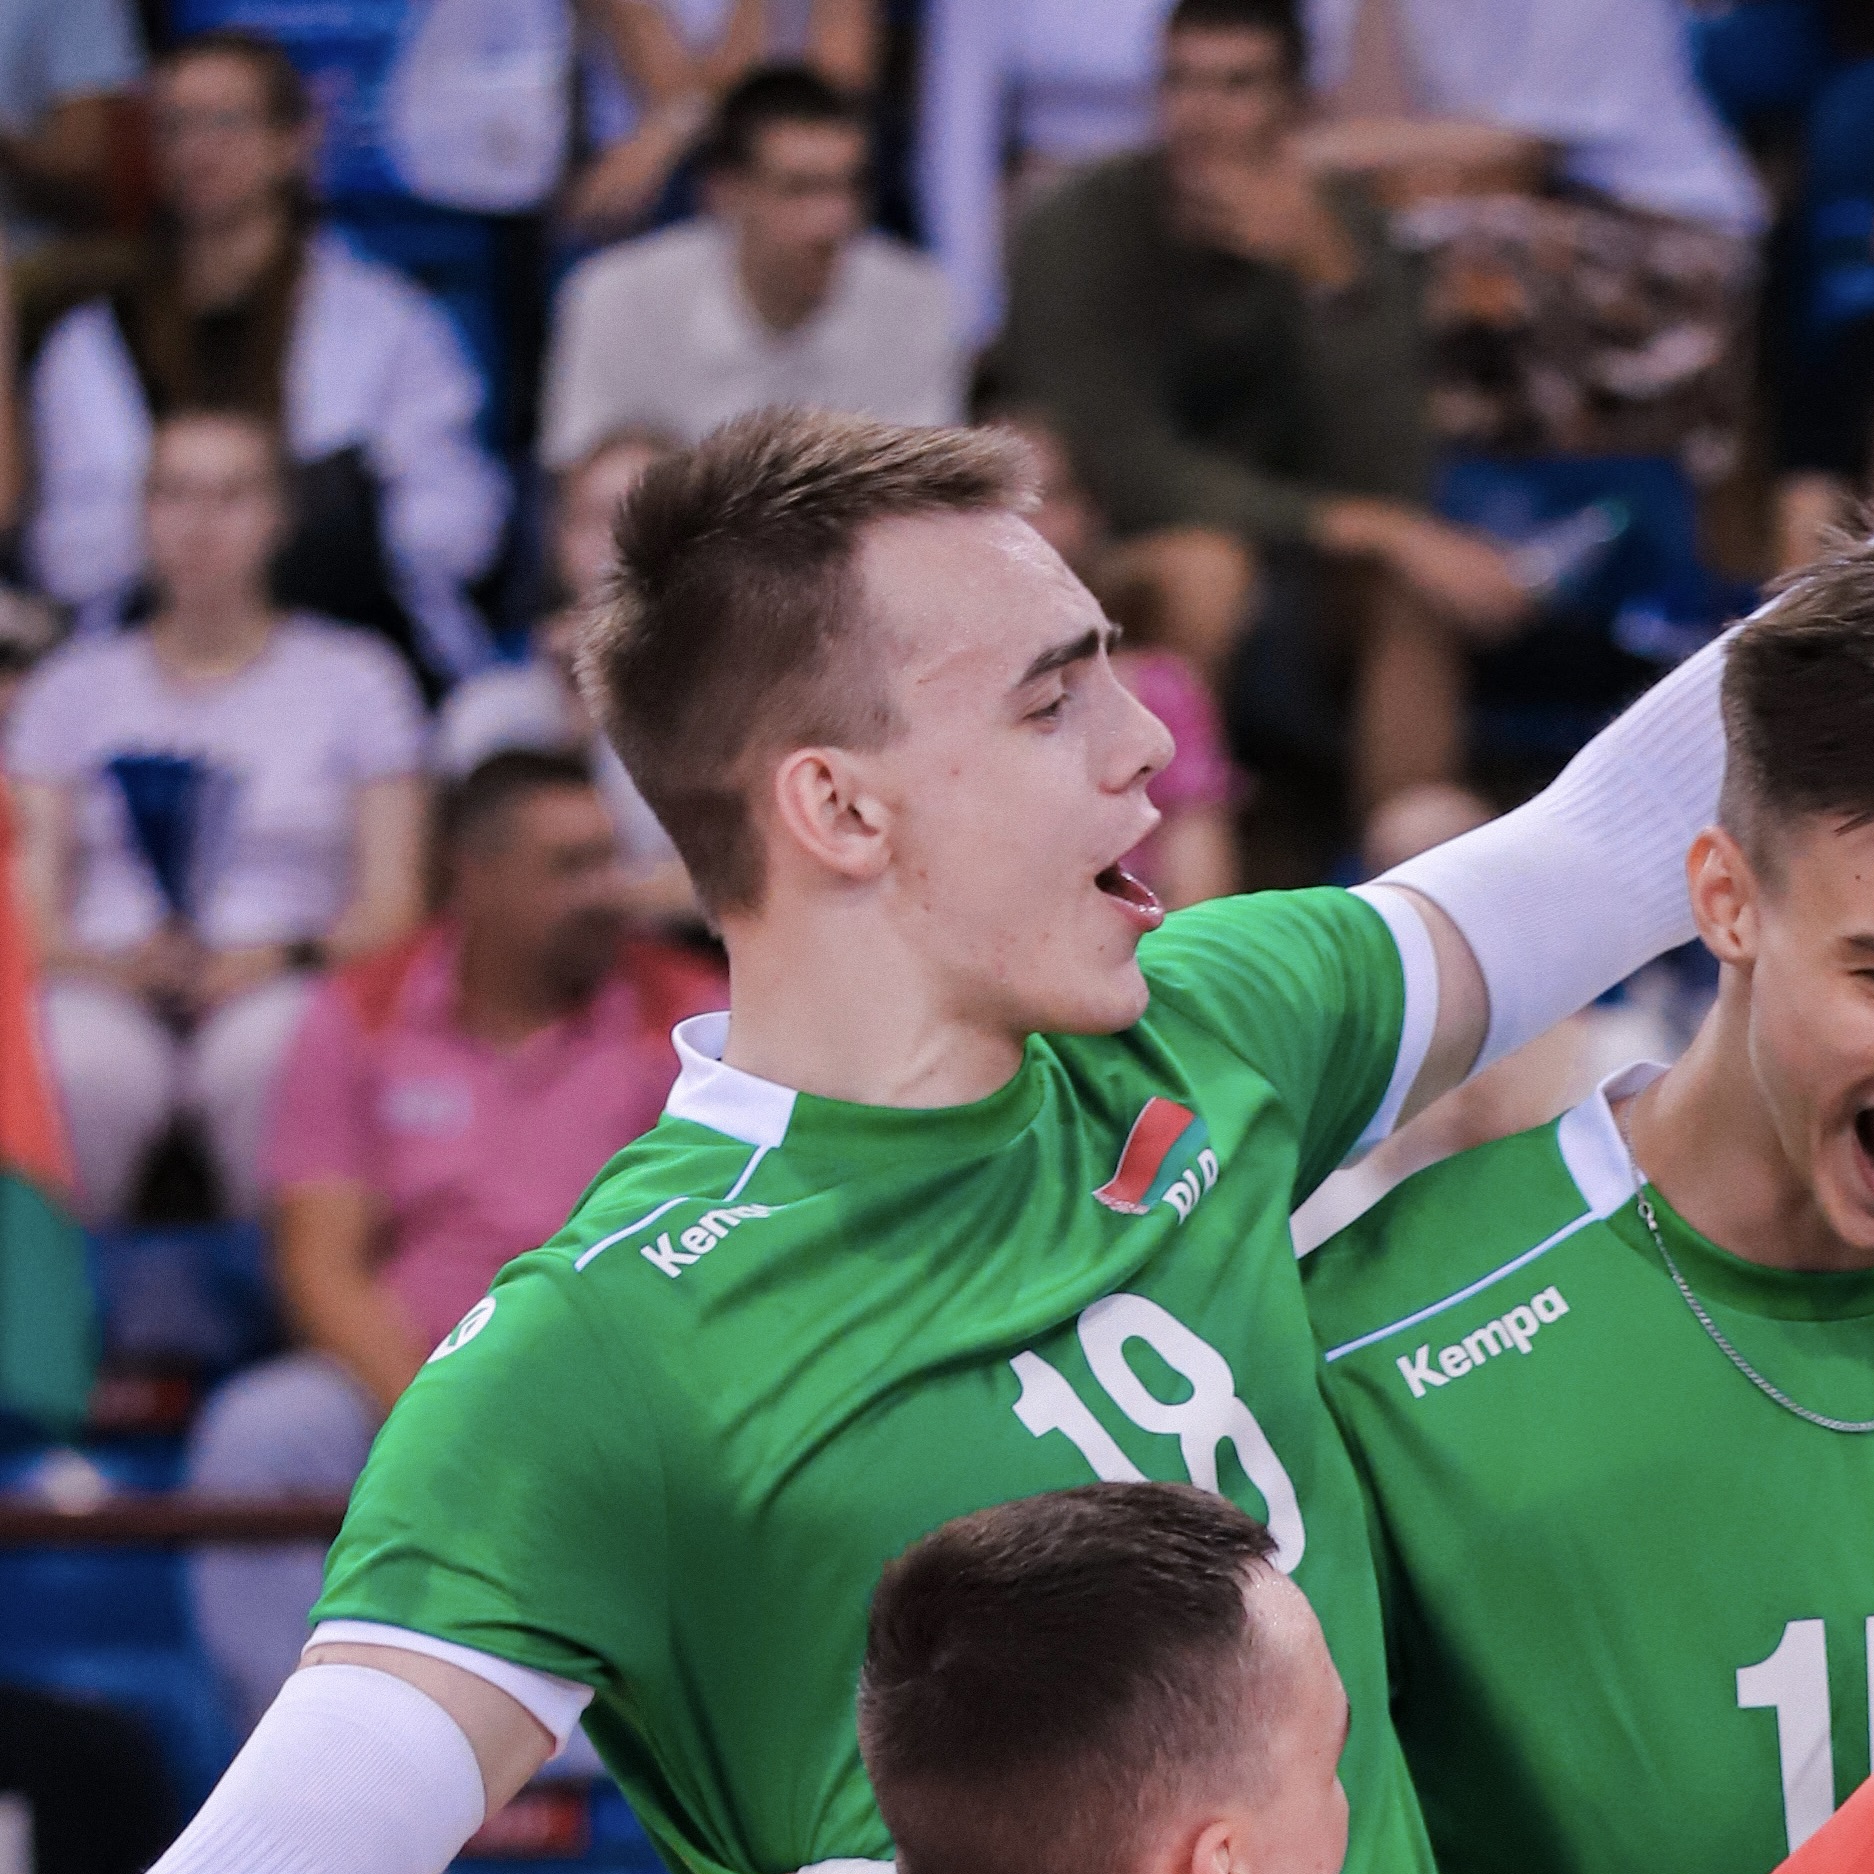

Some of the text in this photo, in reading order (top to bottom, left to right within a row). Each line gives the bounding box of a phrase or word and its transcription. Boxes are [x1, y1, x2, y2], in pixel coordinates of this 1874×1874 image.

[640, 1203, 772, 1278] Kem
[1396, 1285, 1570, 1398] Kempa
[1009, 1293, 1306, 1575] 18
